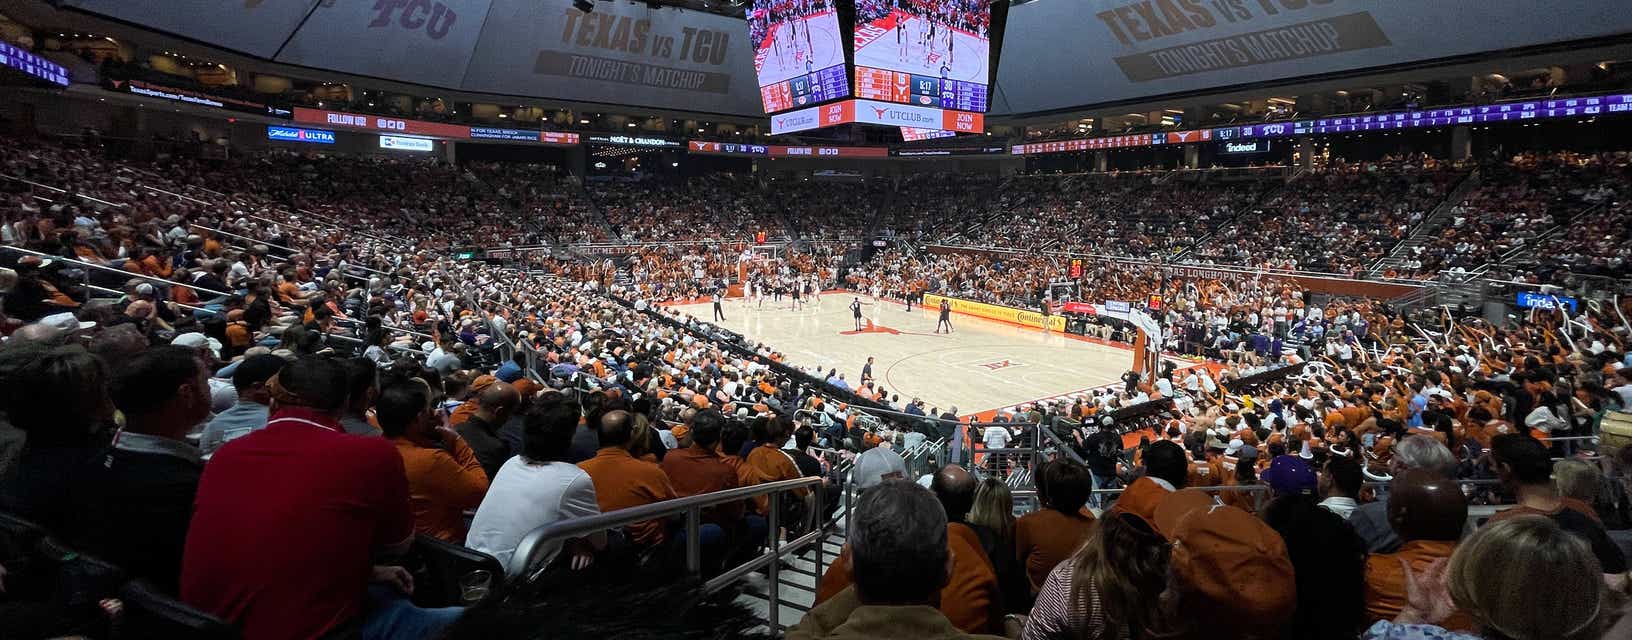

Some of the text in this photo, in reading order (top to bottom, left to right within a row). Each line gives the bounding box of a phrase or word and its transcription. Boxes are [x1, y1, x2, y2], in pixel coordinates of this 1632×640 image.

[368, 0, 456, 39] TCU
[1096, 0, 1217, 48] TEXAS
[561, 8, 730, 65] TEXAS VS TCU
[1152, 22, 1340, 74] TONIGHT'S MATCHUP
[568, 55, 707, 90] TONIGHT'S MATCHUP
[328, 113, 354, 124] FOLLOW
[957, 113, 973, 122] JOIN
[956, 122, 973, 130] NOW
[1263, 125, 1284, 135] TCU
[306, 130, 334, 141] ULTRA
[1226, 142, 1256, 152] indeed
[1188, 269, 1242, 281] LONGHORNS
[1017, 312, 1056, 327] Contineal
